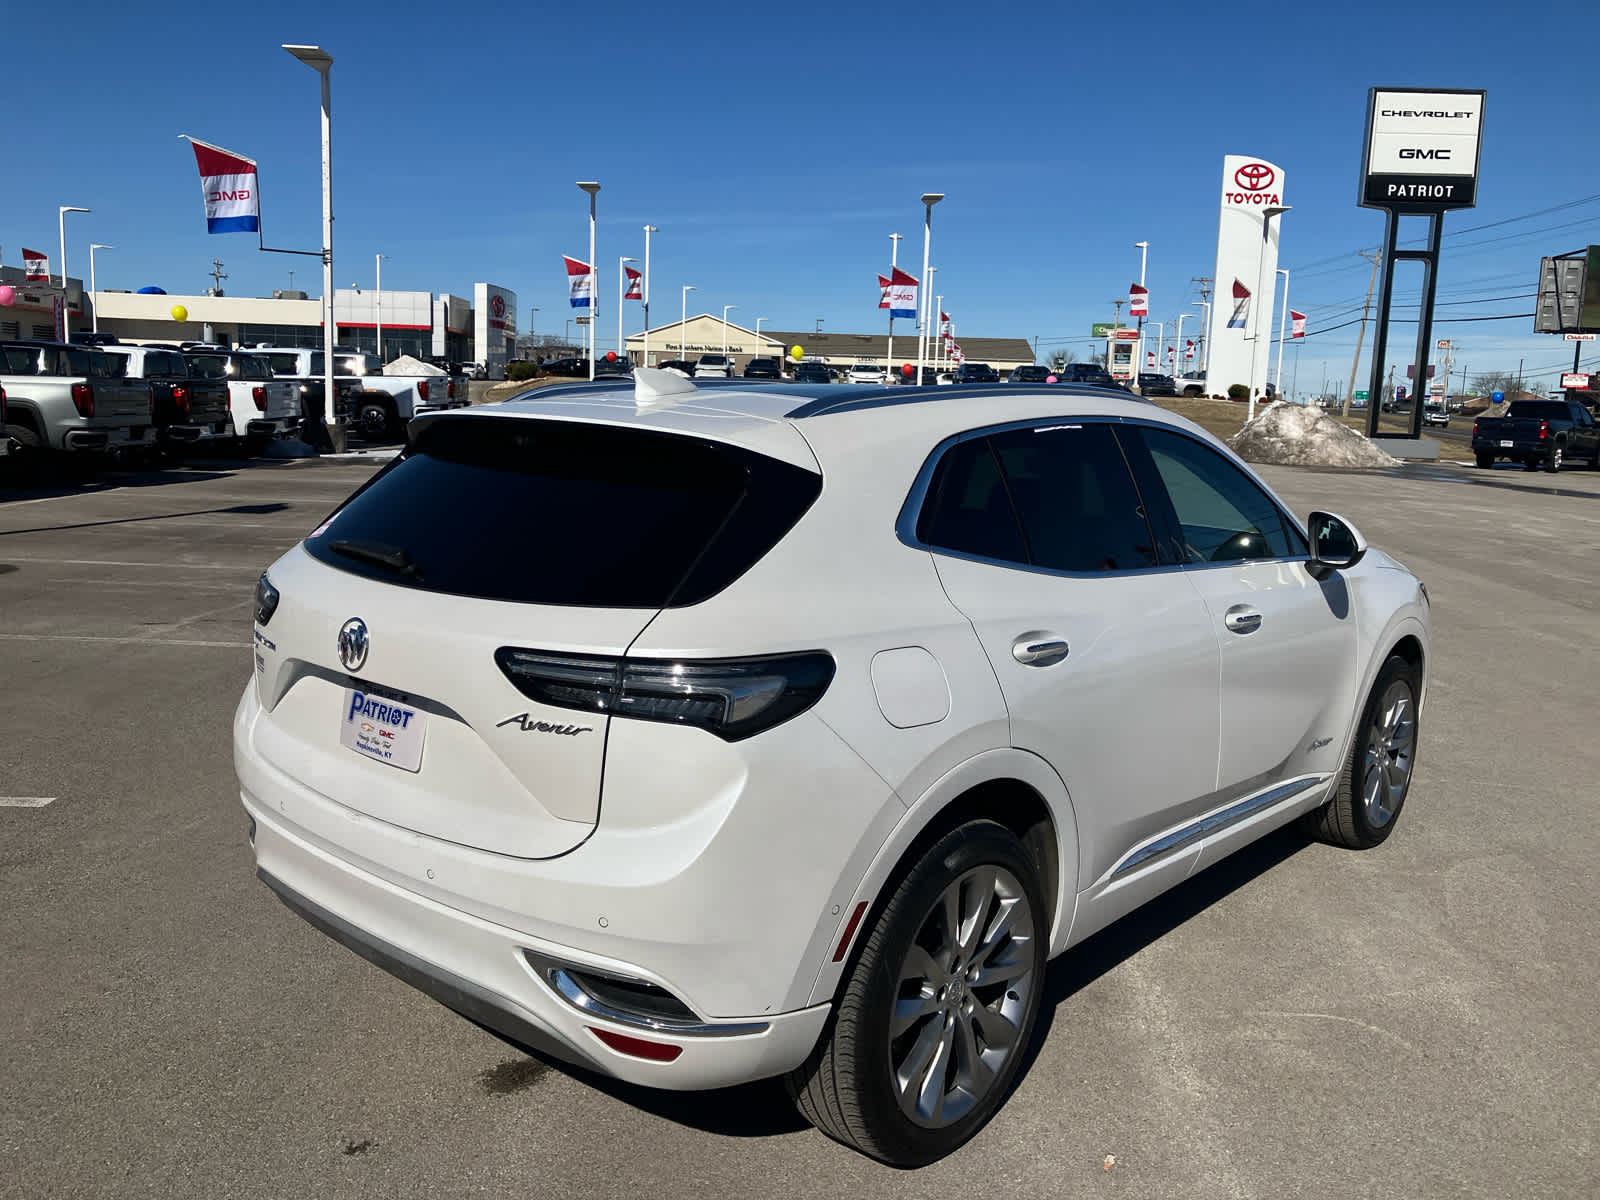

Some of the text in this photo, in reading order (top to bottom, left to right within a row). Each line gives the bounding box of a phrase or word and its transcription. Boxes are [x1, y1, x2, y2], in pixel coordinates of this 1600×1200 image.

[1381, 110, 1473, 118] CHEVROLET
[1399, 148, 1451, 160] GMC
[1387, 184, 1454, 198] PATRIOT
[1226, 192, 1279, 205] TOYOTA
[349, 691, 414, 728] PATRIOT
[496, 713, 592, 736] Avenir
[379, 729, 396, 740] GMC
